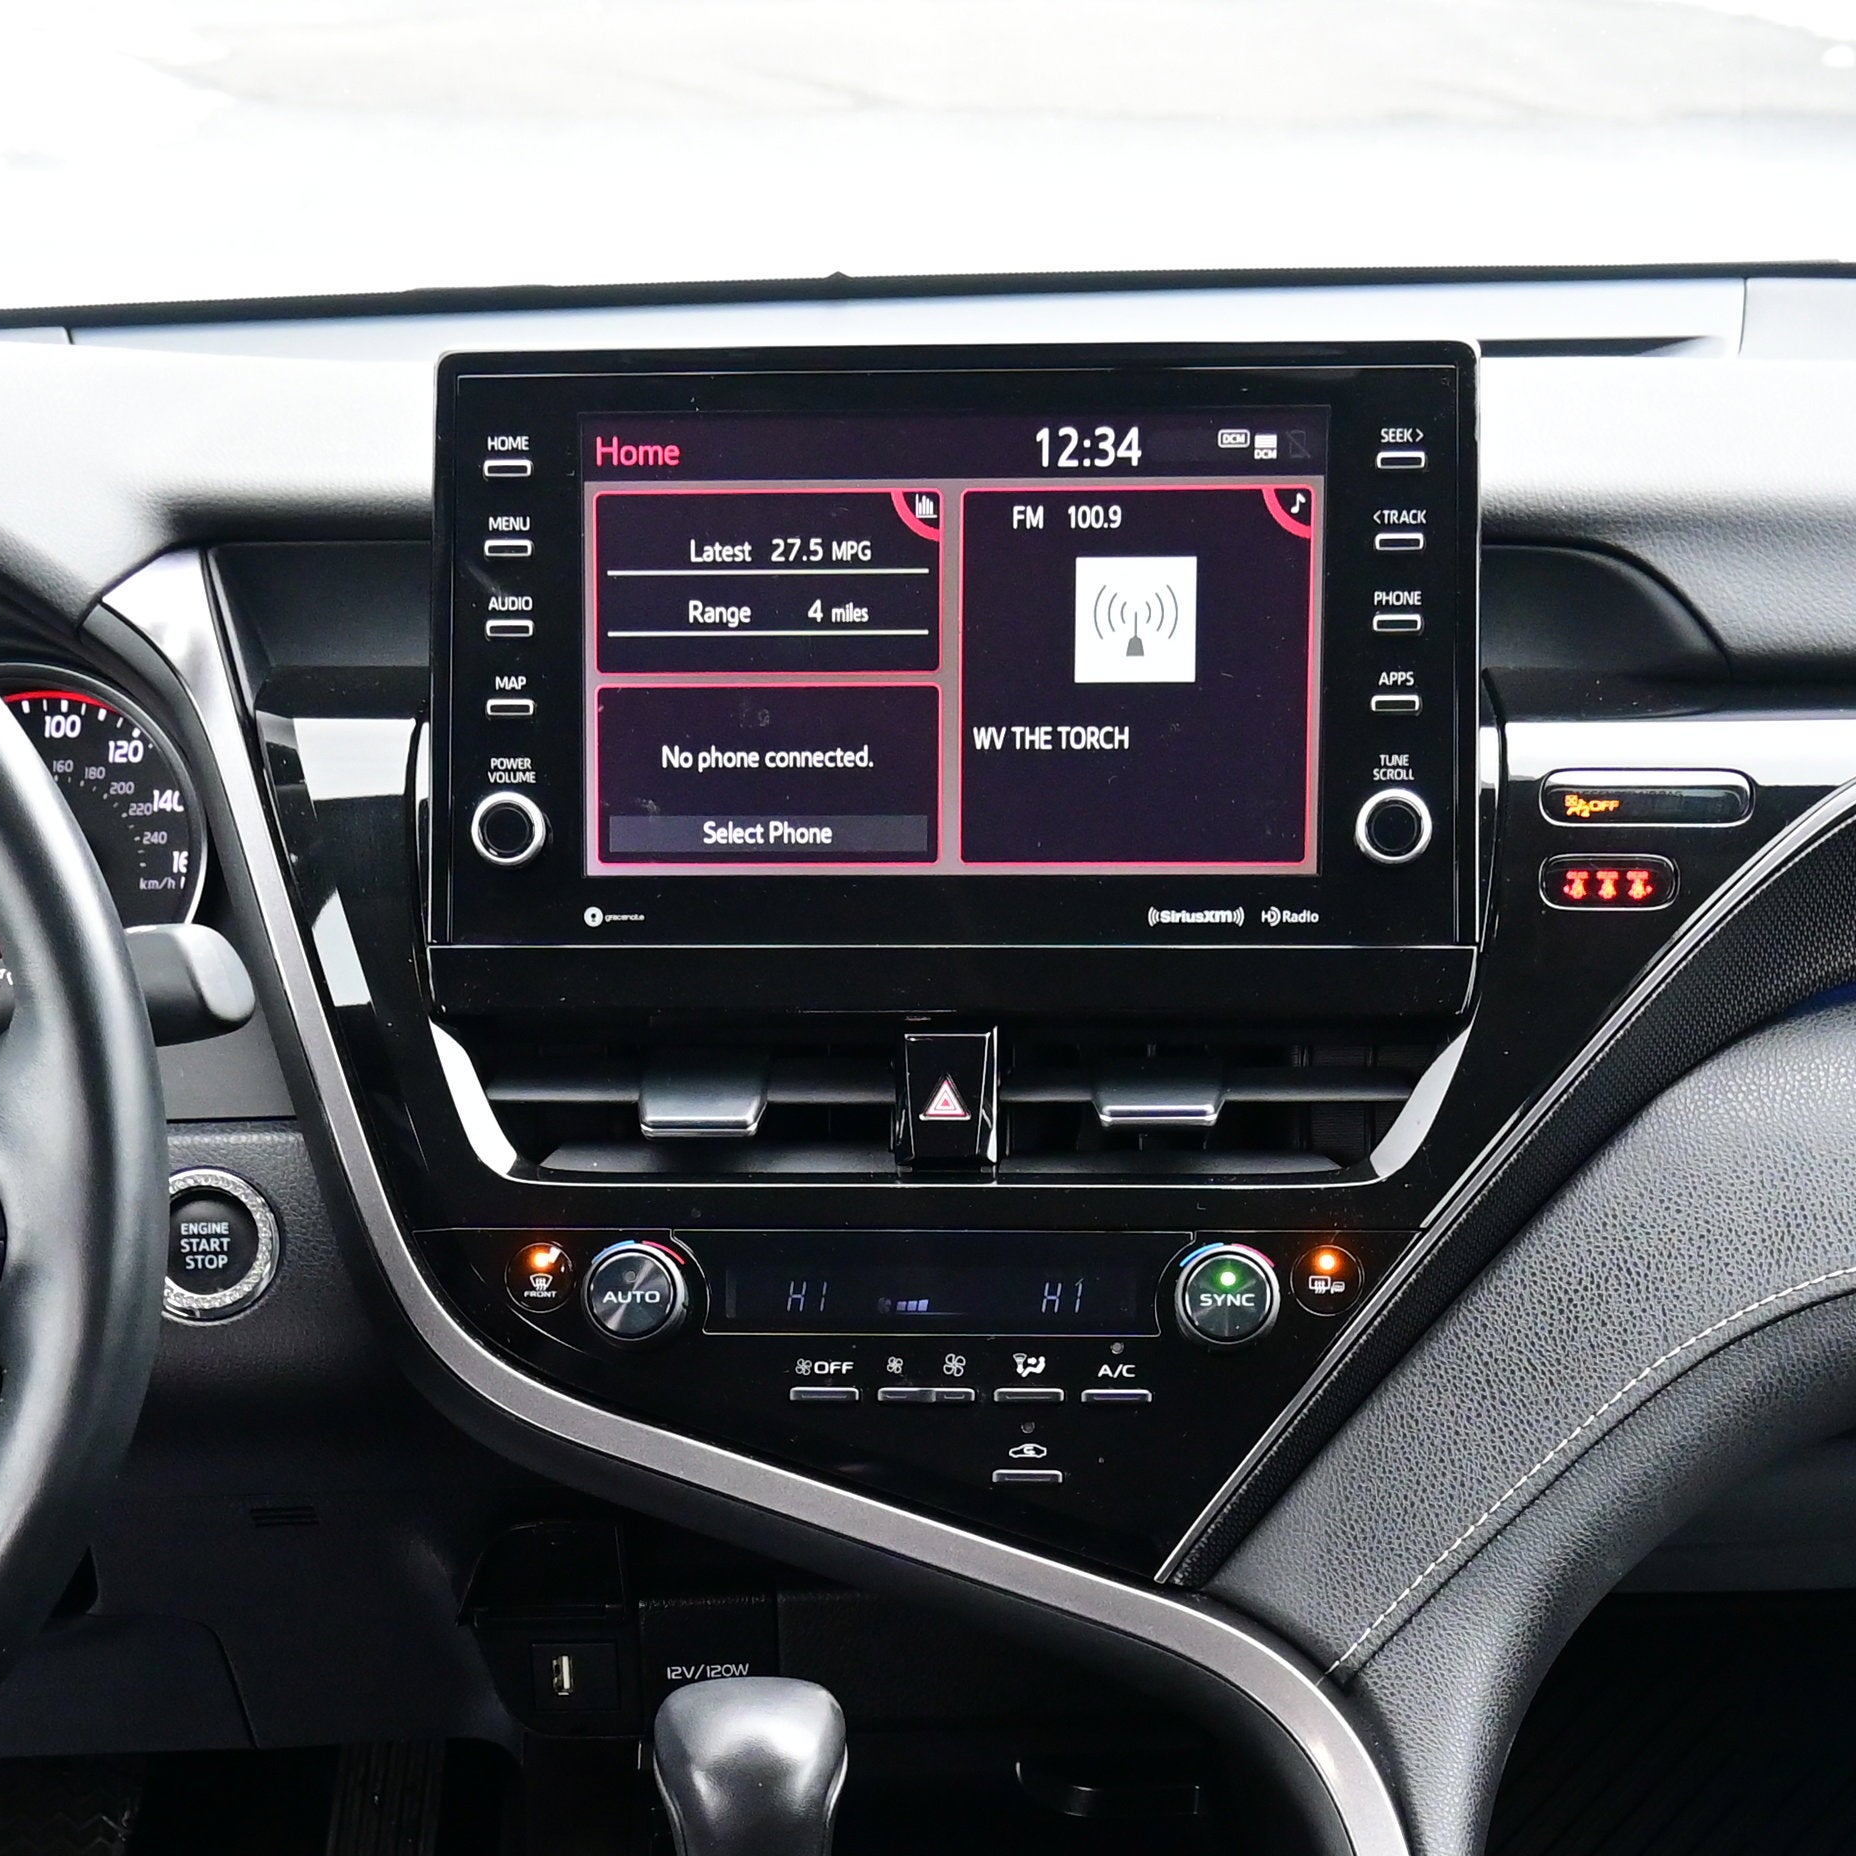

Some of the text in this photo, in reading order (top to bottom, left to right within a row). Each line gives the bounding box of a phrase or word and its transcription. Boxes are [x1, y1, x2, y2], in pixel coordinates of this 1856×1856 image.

[487, 436, 529, 450] HOME
[1222, 434, 1246, 445] DCM
[595, 436, 681, 466] Home
[1036, 427, 1142, 468] 12:34
[1254, 449, 1277, 459] DCM
[488, 517, 531, 531] MENU
[1013, 506, 1122, 529] FM 100.9
[690, 538, 872, 562] Latest 27.5 MPG
[488, 597, 533, 611] AUDIO
[1374, 591, 1421, 606] PHONE
[688, 600, 869, 627] Range 4 miles
[495, 676, 527, 690] MAP
[1378, 672, 1414, 686] APPS
[44, 715, 81, 739] 100
[973, 726, 1130, 750] WV THE TORCH
[109, 740, 143, 763] 120
[491, 758, 531, 770] POWER
[662, 746, 874, 772] No phone connected.
[1379, 755, 1409, 767] TUNE
[52, 760, 74, 773] 160
[84, 766, 106, 780] 180
[488, 771, 536, 784] VOLUME
[1373, 768, 1414, 781] SCROLL
[110, 781, 135, 795] 200
[129, 802, 153, 816] 220
[1590, 800, 1620, 812] OFF
[143, 832, 167, 845] 240
[703, 819, 832, 845] Select Phone
[139, 877, 176, 890] km/h
[1282, 909, 1319, 923] Radio
[181, 1223, 230, 1236] ENGINE
[180, 1238, 231, 1254] START
[185, 1254, 229, 1269] STOP
[524, 1290, 557, 1299] FRONT
[602, 1290, 661, 1304] AUTO
[1200, 1293, 1255, 1307] SYNC
[814, 1361, 854, 1375] OFF
[1098, 1364, 1136, 1378] A/C
[667, 1663, 749, 1679] 12V/120W
